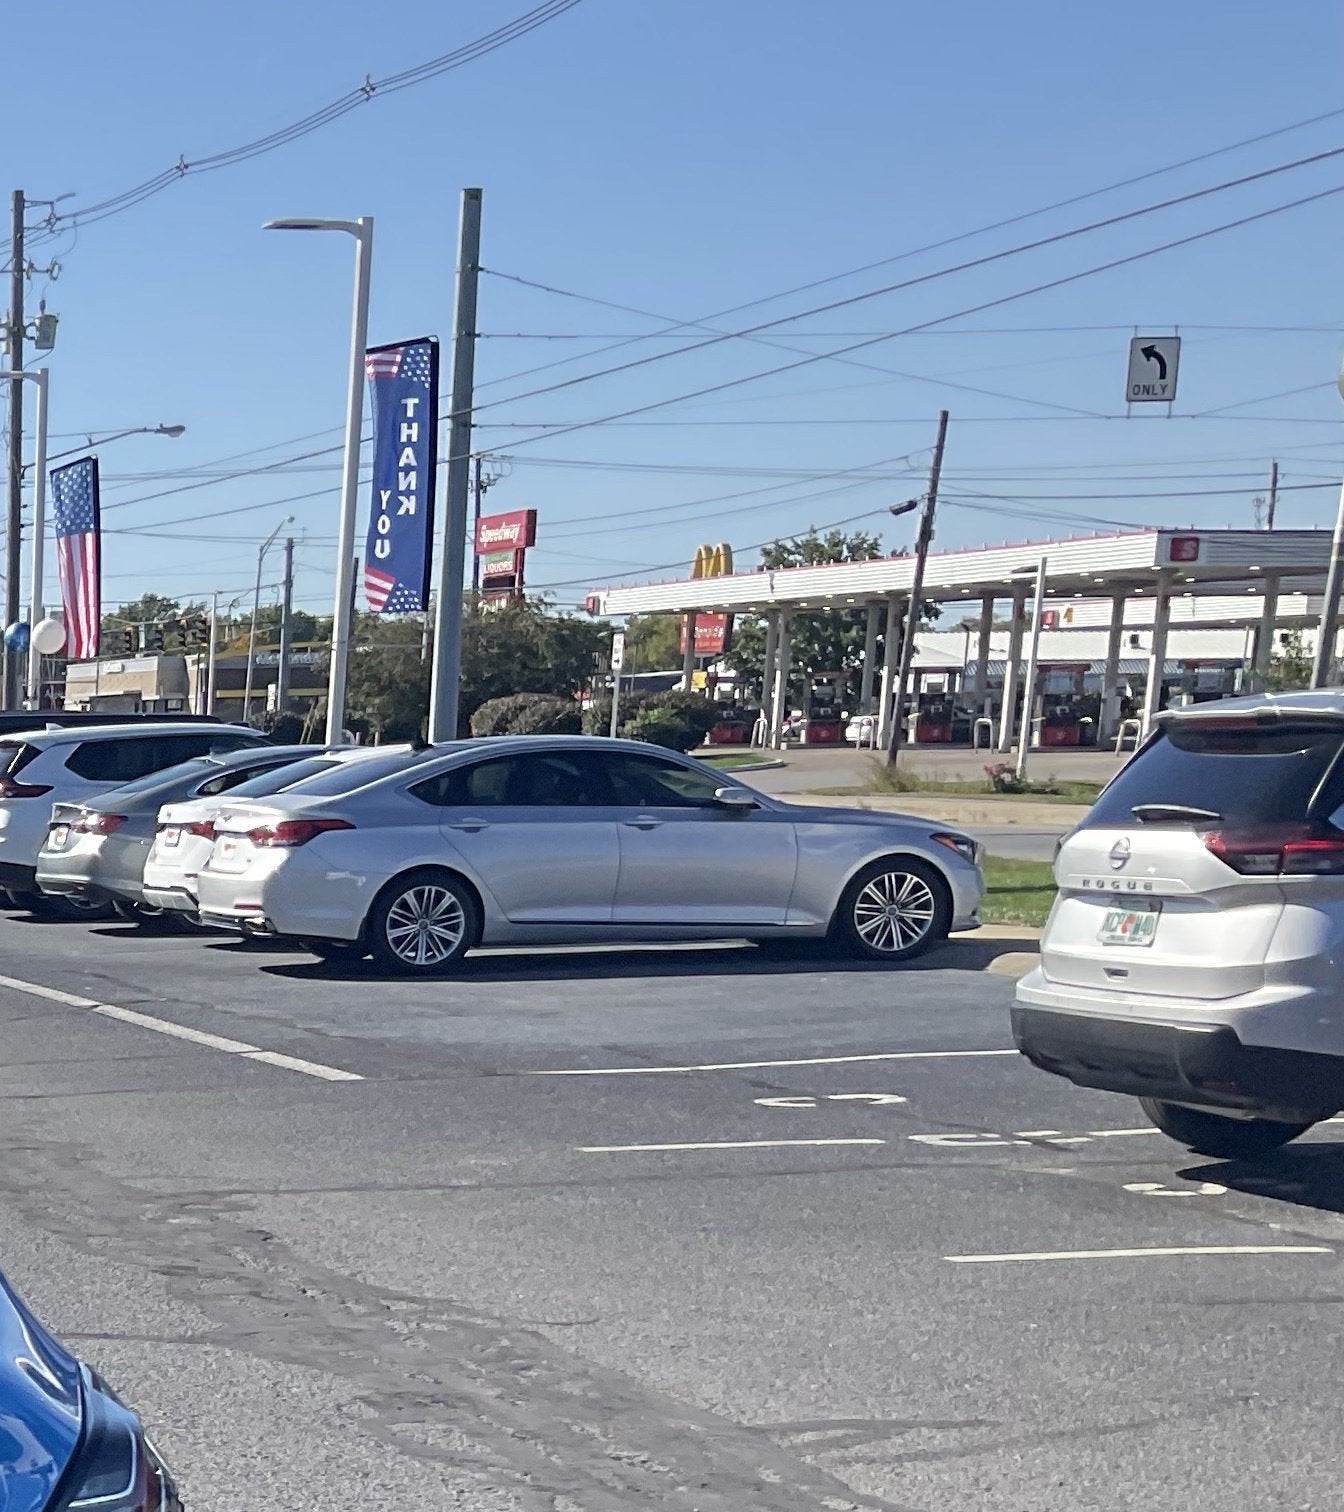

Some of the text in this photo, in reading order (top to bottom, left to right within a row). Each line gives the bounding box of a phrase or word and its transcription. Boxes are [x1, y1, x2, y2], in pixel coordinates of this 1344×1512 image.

[1132, 383, 1169, 396] ONLY
[479, 521, 521, 548] Speedway
[1082, 879, 1153, 891] ROGUE
